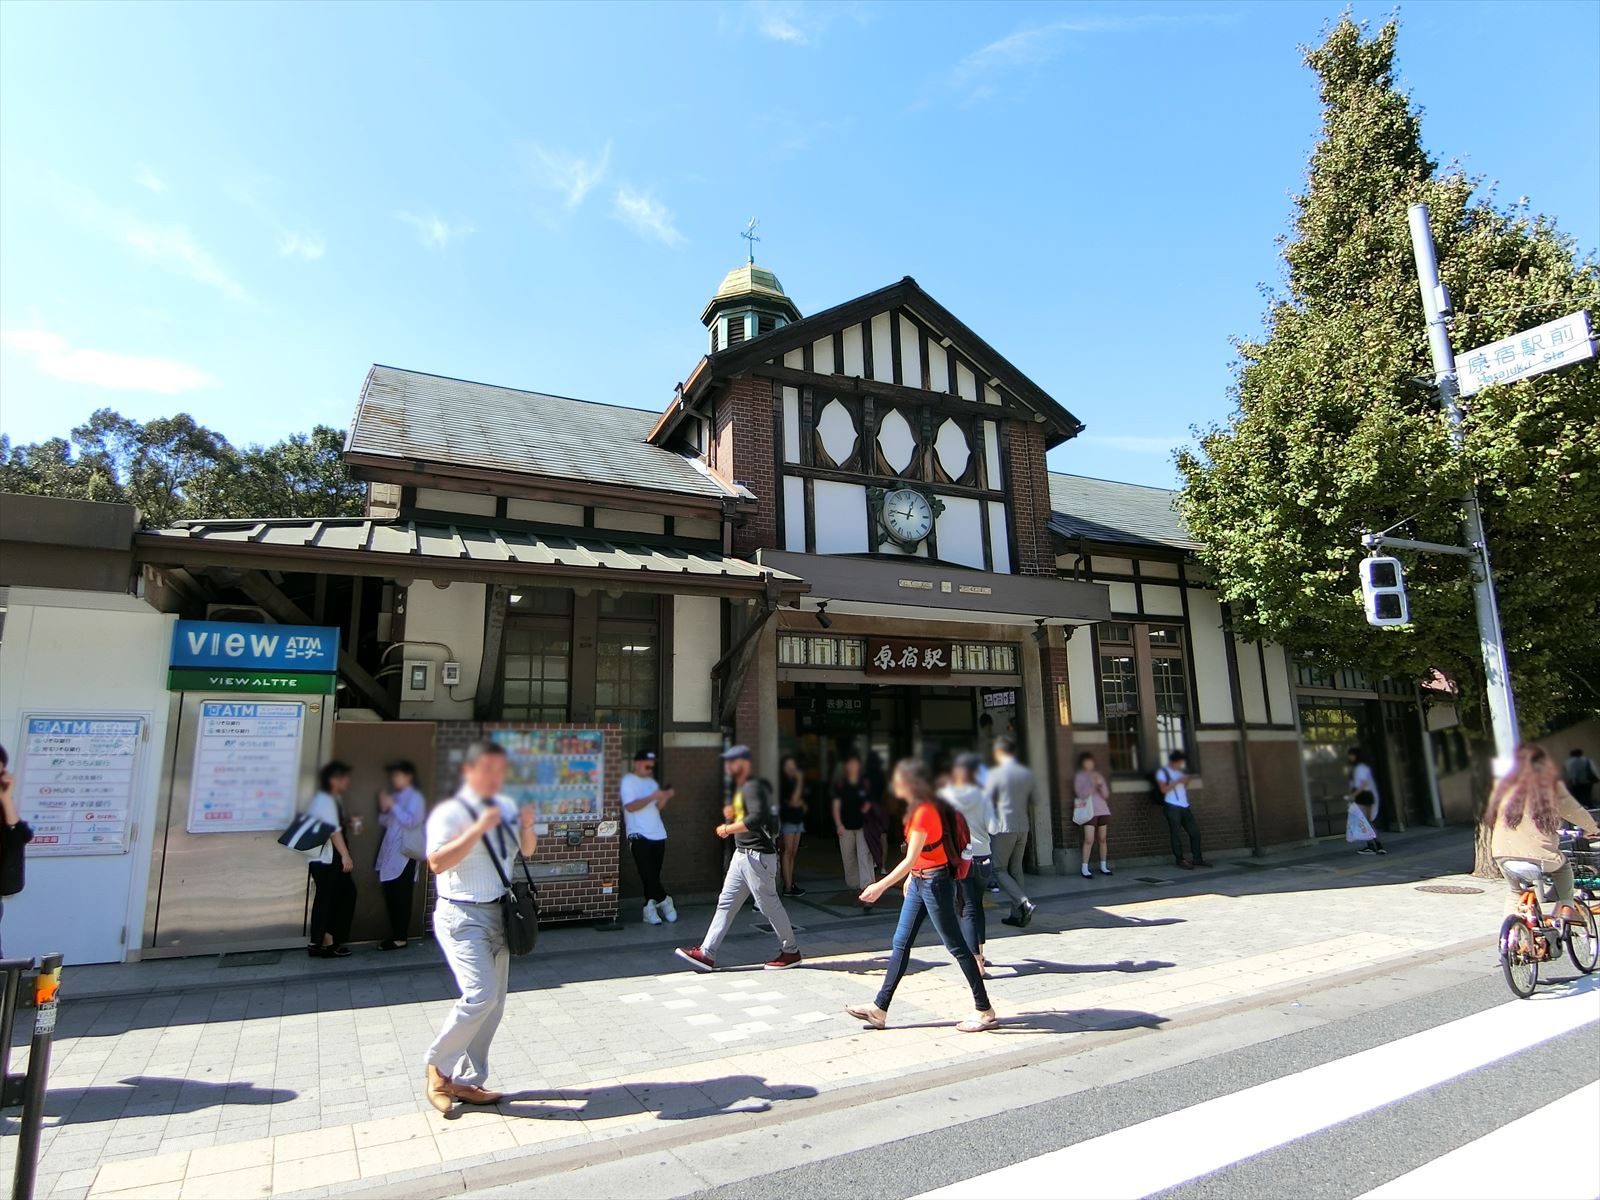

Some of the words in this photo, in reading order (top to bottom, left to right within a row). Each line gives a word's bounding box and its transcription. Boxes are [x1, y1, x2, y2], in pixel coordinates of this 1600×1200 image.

[1467, 324, 1575, 375] 原宿駅前
[286, 636, 322, 650] ATM
[284, 648, 325, 660] コーナー
[872, 644, 948, 670] 原宿駅
[209, 677, 250, 686] VIEW
[250, 678, 298, 687] ALTTE
[222, 704, 255, 717] ATM
[50, 720, 87, 733] ATM
